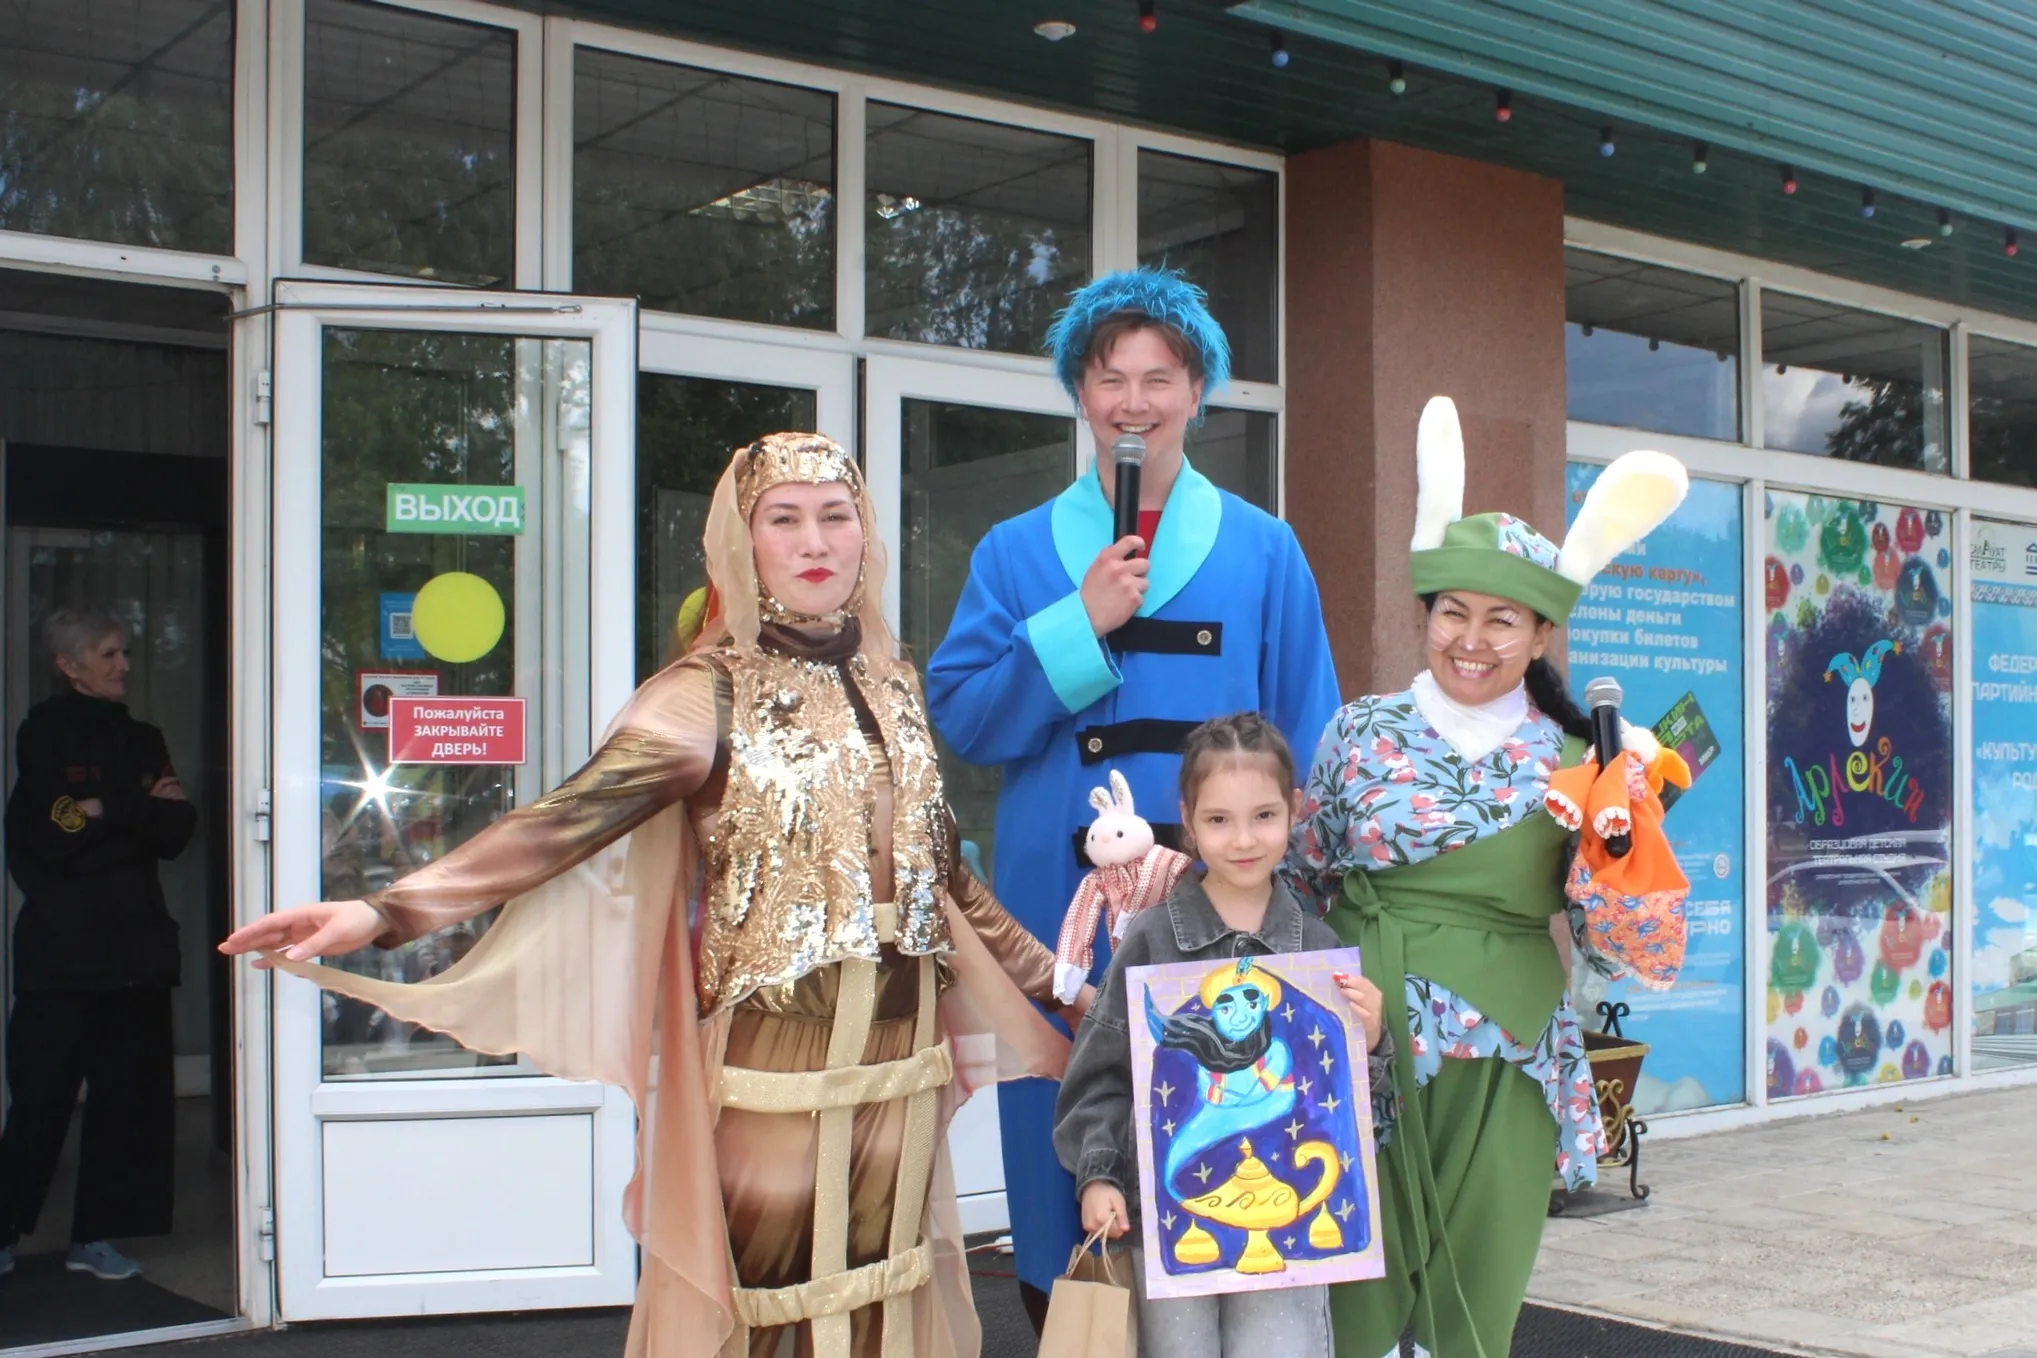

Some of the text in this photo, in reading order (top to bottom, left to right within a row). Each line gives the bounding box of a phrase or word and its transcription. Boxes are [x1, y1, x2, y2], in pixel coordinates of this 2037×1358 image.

[395, 493, 520, 528] ВЫХОД
[1627, 586, 1735, 608] государством
[1626, 607, 1682, 626] деньги
[1634, 627, 1699, 649] билетов
[1654, 655, 1728, 675] культуры
[413, 706, 505, 722] Пожалуйста
[414, 723, 505, 737] ЗАКРЫВАЙТЕ
[431, 742, 488, 758] ДВЕРЬ!
